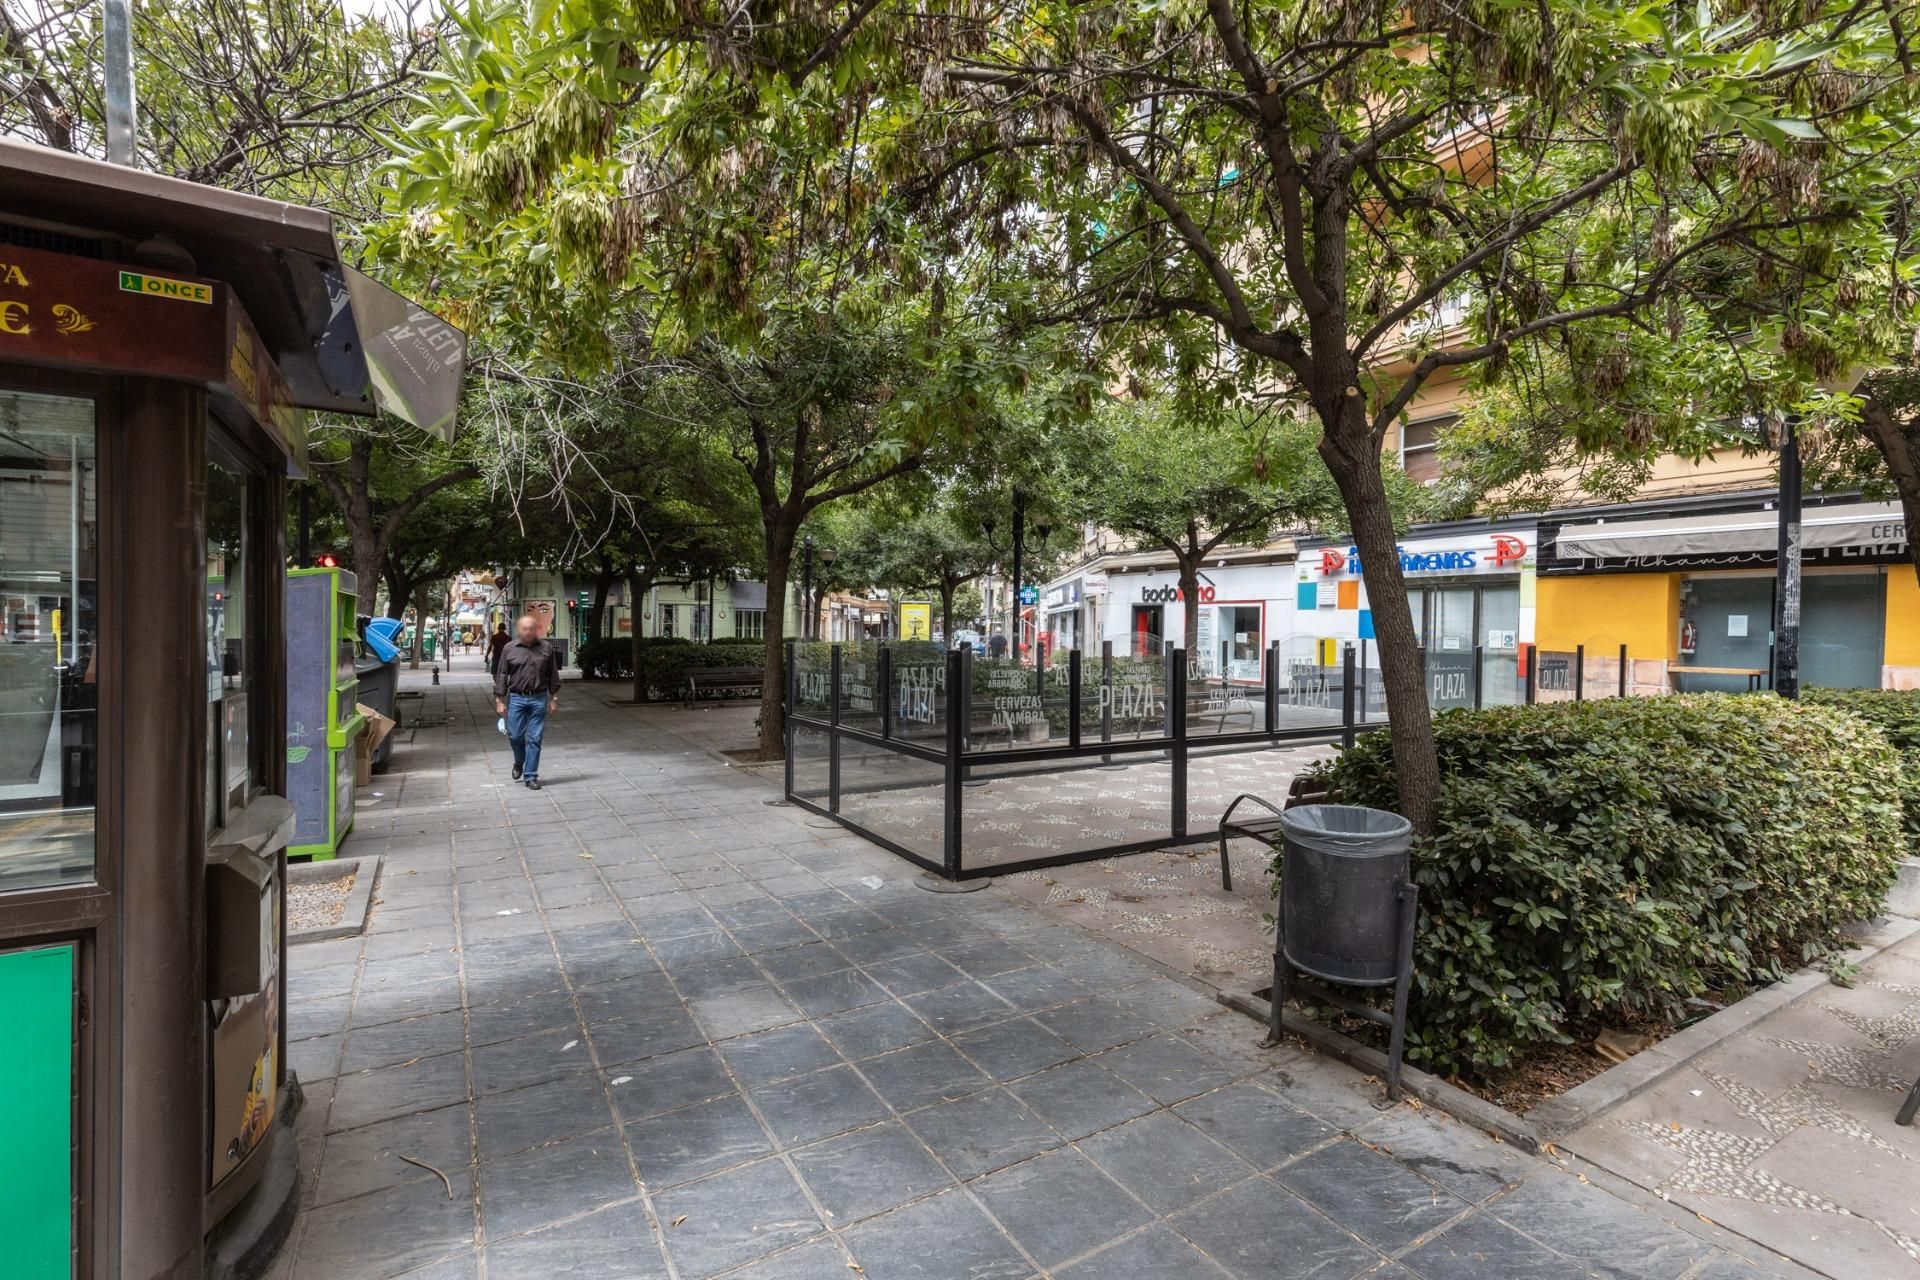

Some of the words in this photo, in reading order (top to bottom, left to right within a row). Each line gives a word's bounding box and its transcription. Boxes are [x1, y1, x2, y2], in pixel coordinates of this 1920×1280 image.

[147, 280, 206, 299] ONCE
[1871, 524, 1905, 539] CER
[1433, 673, 1466, 701] PLAZA
[900, 685, 936, 725] PLAZA
[994, 695, 1042, 711] CERVEZAS
[1100, 684, 1155, 719] PLAZA
[991, 709, 1045, 727] ALHAMBRA
